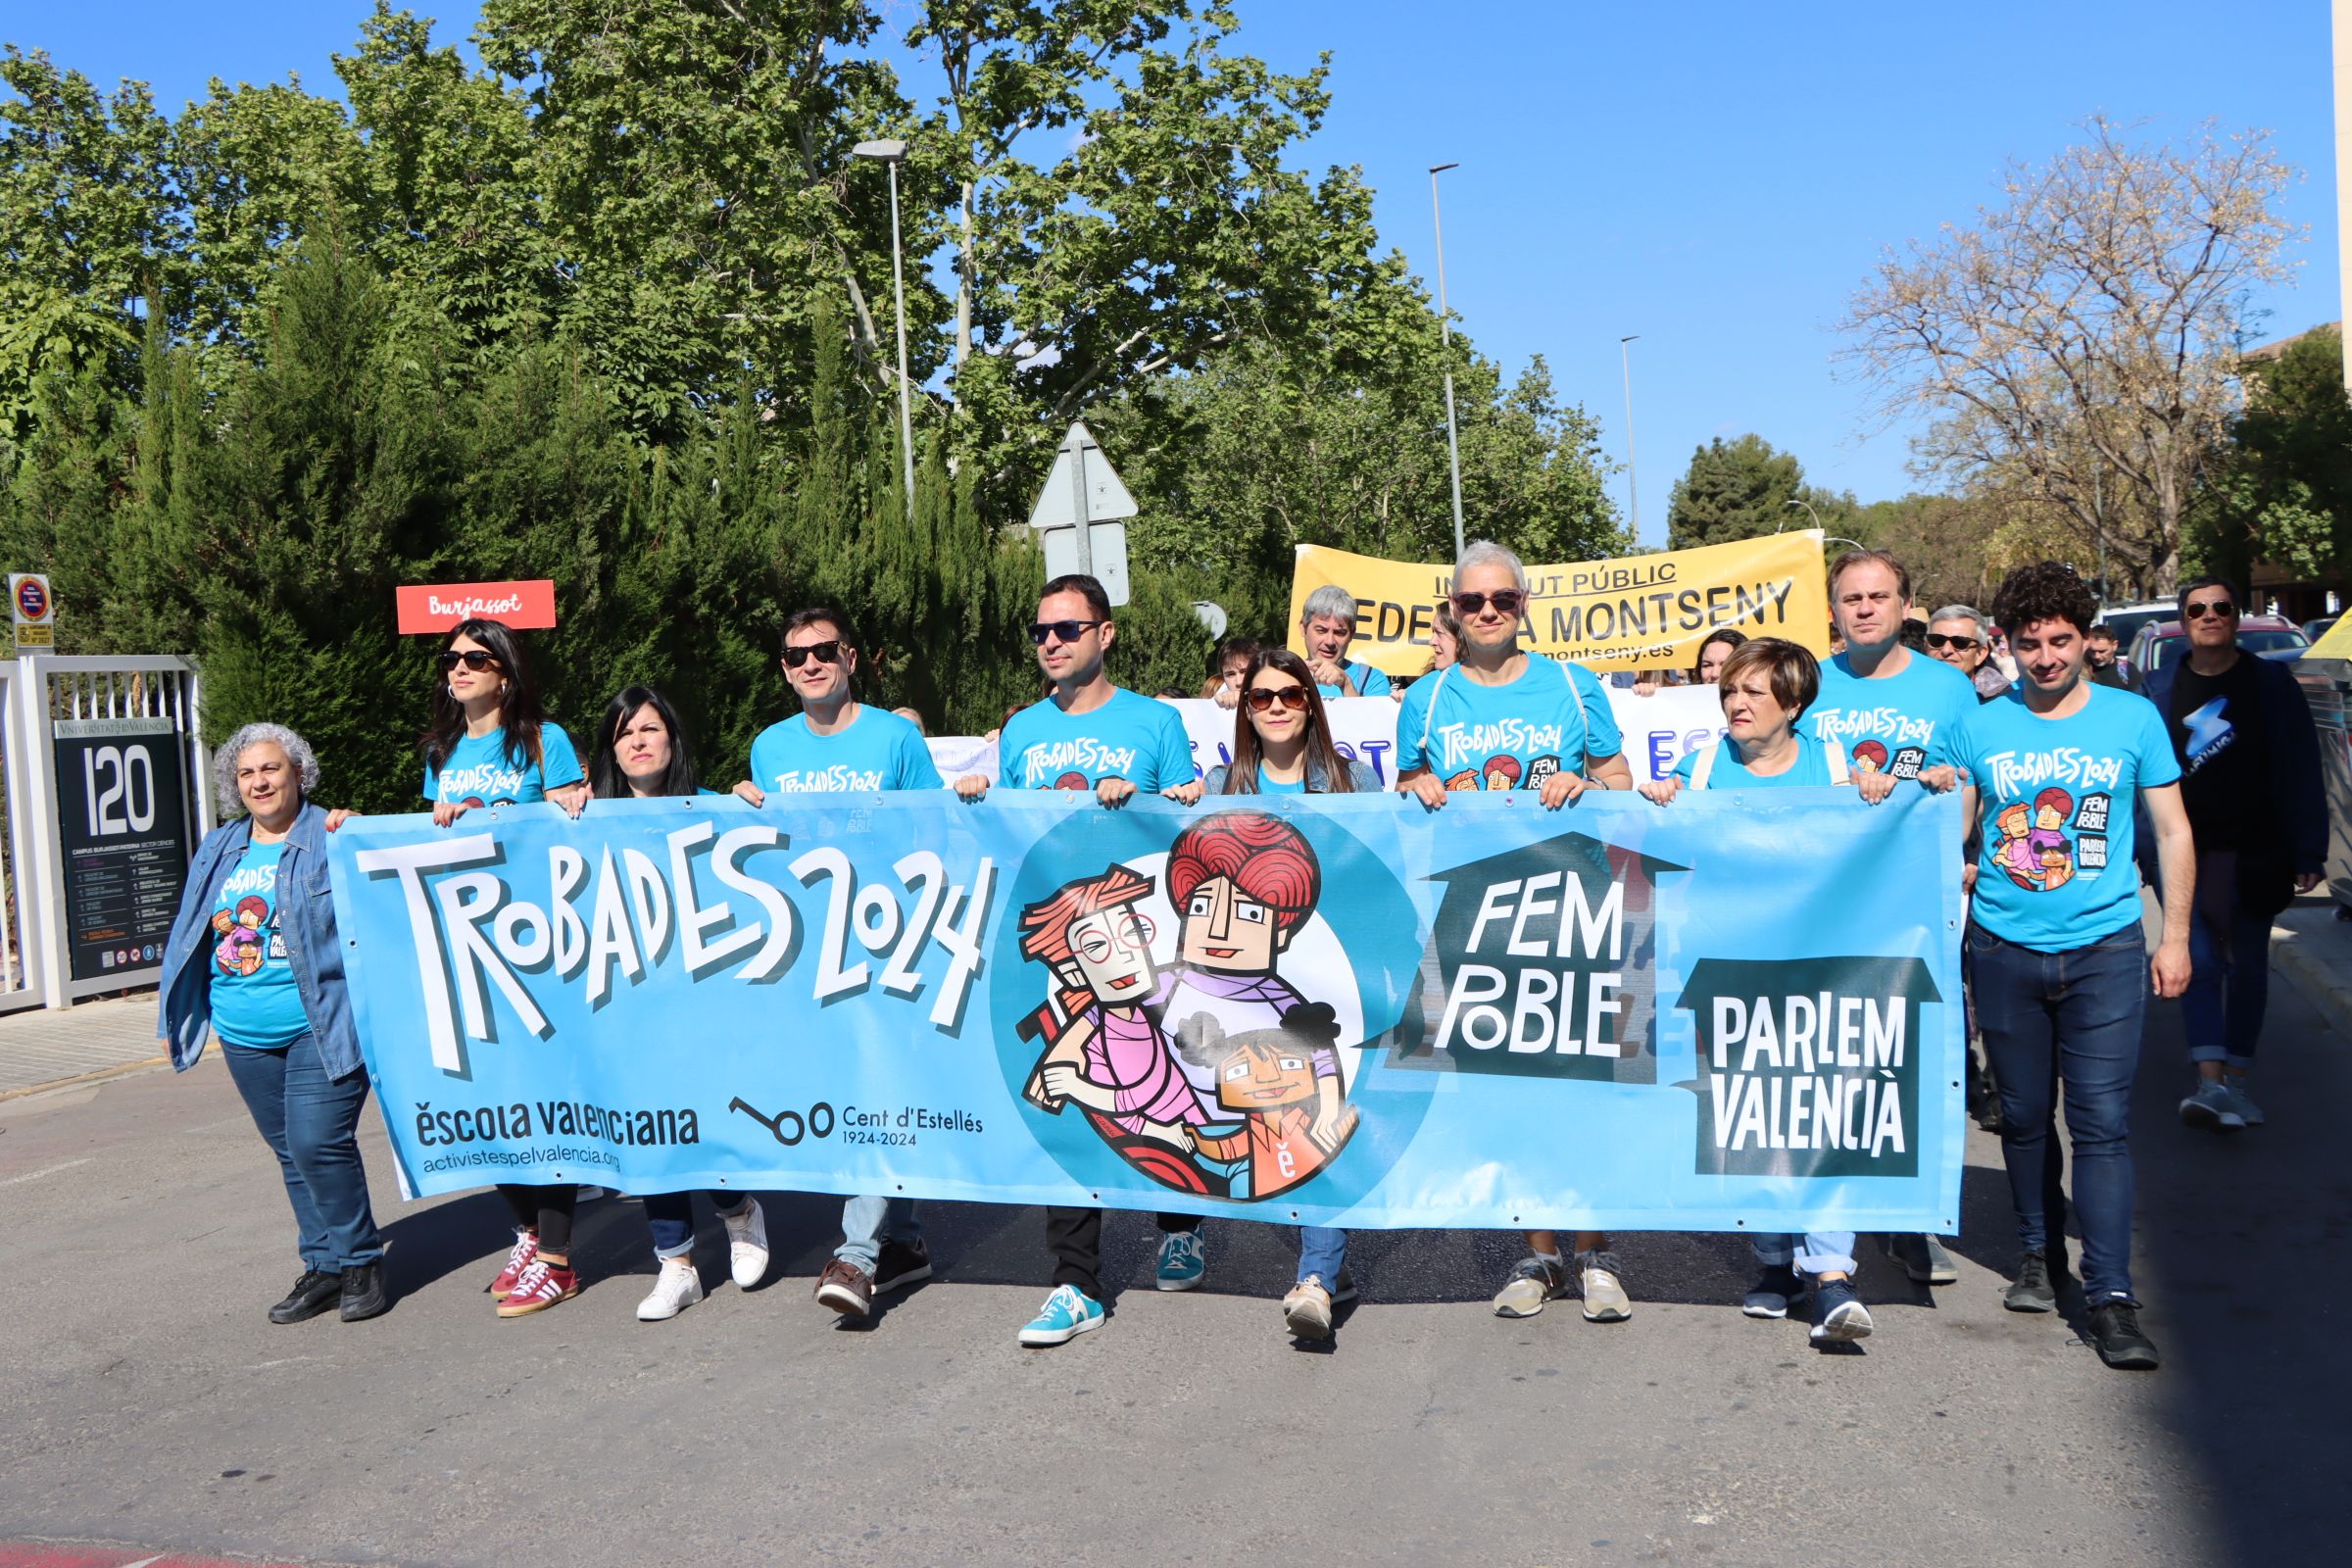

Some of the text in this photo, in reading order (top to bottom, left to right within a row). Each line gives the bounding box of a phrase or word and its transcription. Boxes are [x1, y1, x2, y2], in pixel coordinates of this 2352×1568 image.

[1573, 564, 1677, 593] PÚBLIC
[428, 594, 522, 621] Burjassot
[1551, 579, 1792, 644] MONTSENY
[1438, 718, 1525, 770] TROBADES
[1524, 724, 1562, 755] 2024
[1812, 708, 1936, 746] TROBADES 2024
[1023, 737, 1099, 788] TROBADES
[1097, 745, 1136, 775] 2024
[1532, 759, 1558, 774] FEM
[1897, 750, 1923, 764] FEM
[1984, 748, 2123, 804] TROBADES 2024
[84, 745, 155, 836] 120
[2082, 797, 2108, 812] FEM
[2076, 811, 2106, 830] POBLE
[1466, 870, 1624, 960] FEM
[356, 821, 996, 1076] TROBADES 2024
[1434, 964, 1622, 1058] POBLE
[1712, 991, 1906, 1073] PARLEM
[536, 1101, 700, 1146] valenciana
[843, 1105, 983, 1134] Cent d'Estellés
[1711, 1070, 1905, 1157] VALENCIÀ
[422, 1145, 621, 1173] activistespelvalencia.org
[843, 1130, 916, 1146] 1924-2024
